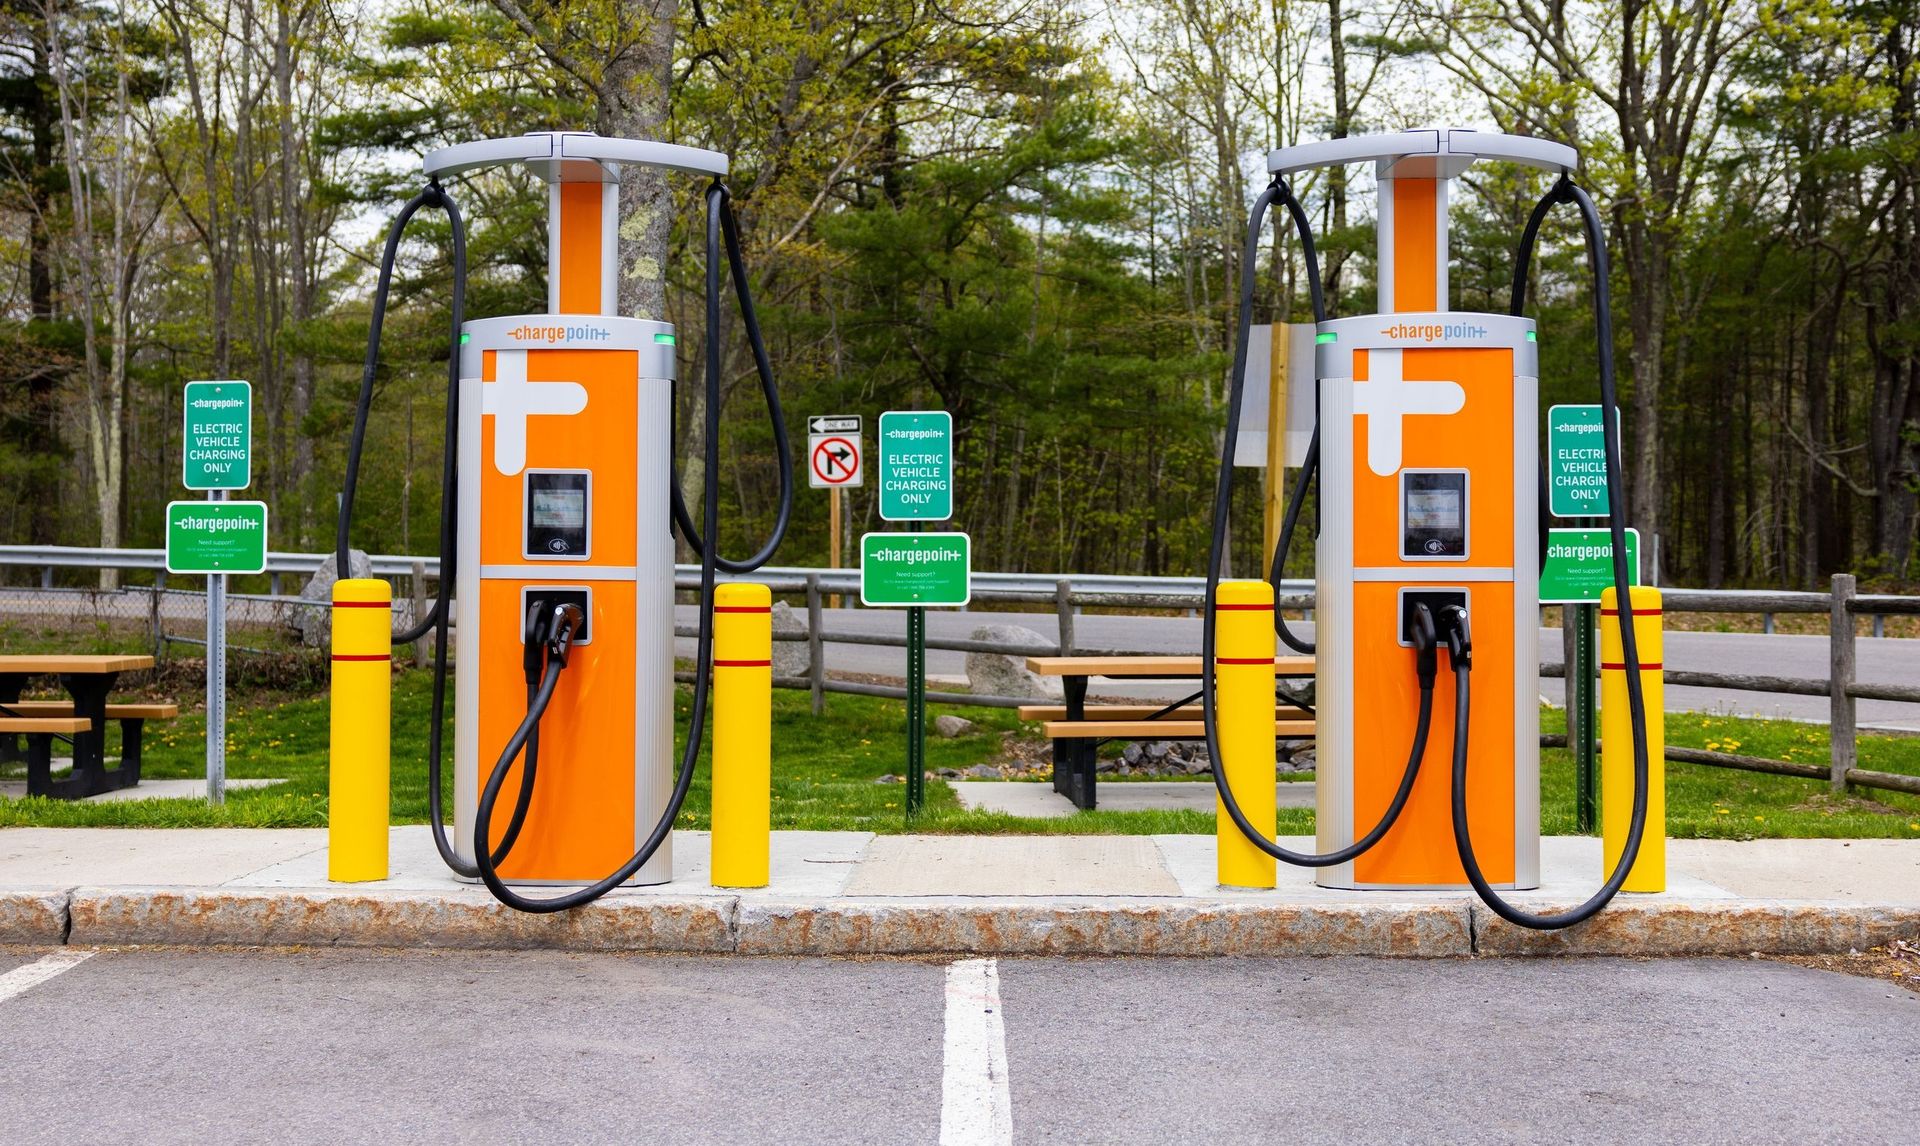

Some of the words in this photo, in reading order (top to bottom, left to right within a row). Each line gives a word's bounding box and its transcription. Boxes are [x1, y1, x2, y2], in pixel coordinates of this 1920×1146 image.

[193, 423, 243, 434] ELECTRIC
[841, 420, 855, 428] WAY
[196, 436, 240, 447] VEHICLE
[189, 449, 246, 461] CHARGING
[889, 454, 943, 465] ELECTRIC
[1559, 448, 1605, 460] ELECTRI
[203, 462, 232, 473] ONLY
[892, 467, 940, 478] VEHICLE
[1561, 462, 1606, 473] VEHICLE
[885, 480, 947, 491] CHARGING
[1555, 475, 1607, 487] CHARGIN
[900, 493, 932, 504] ONLY
[1570, 489, 1601, 500] ONLY
